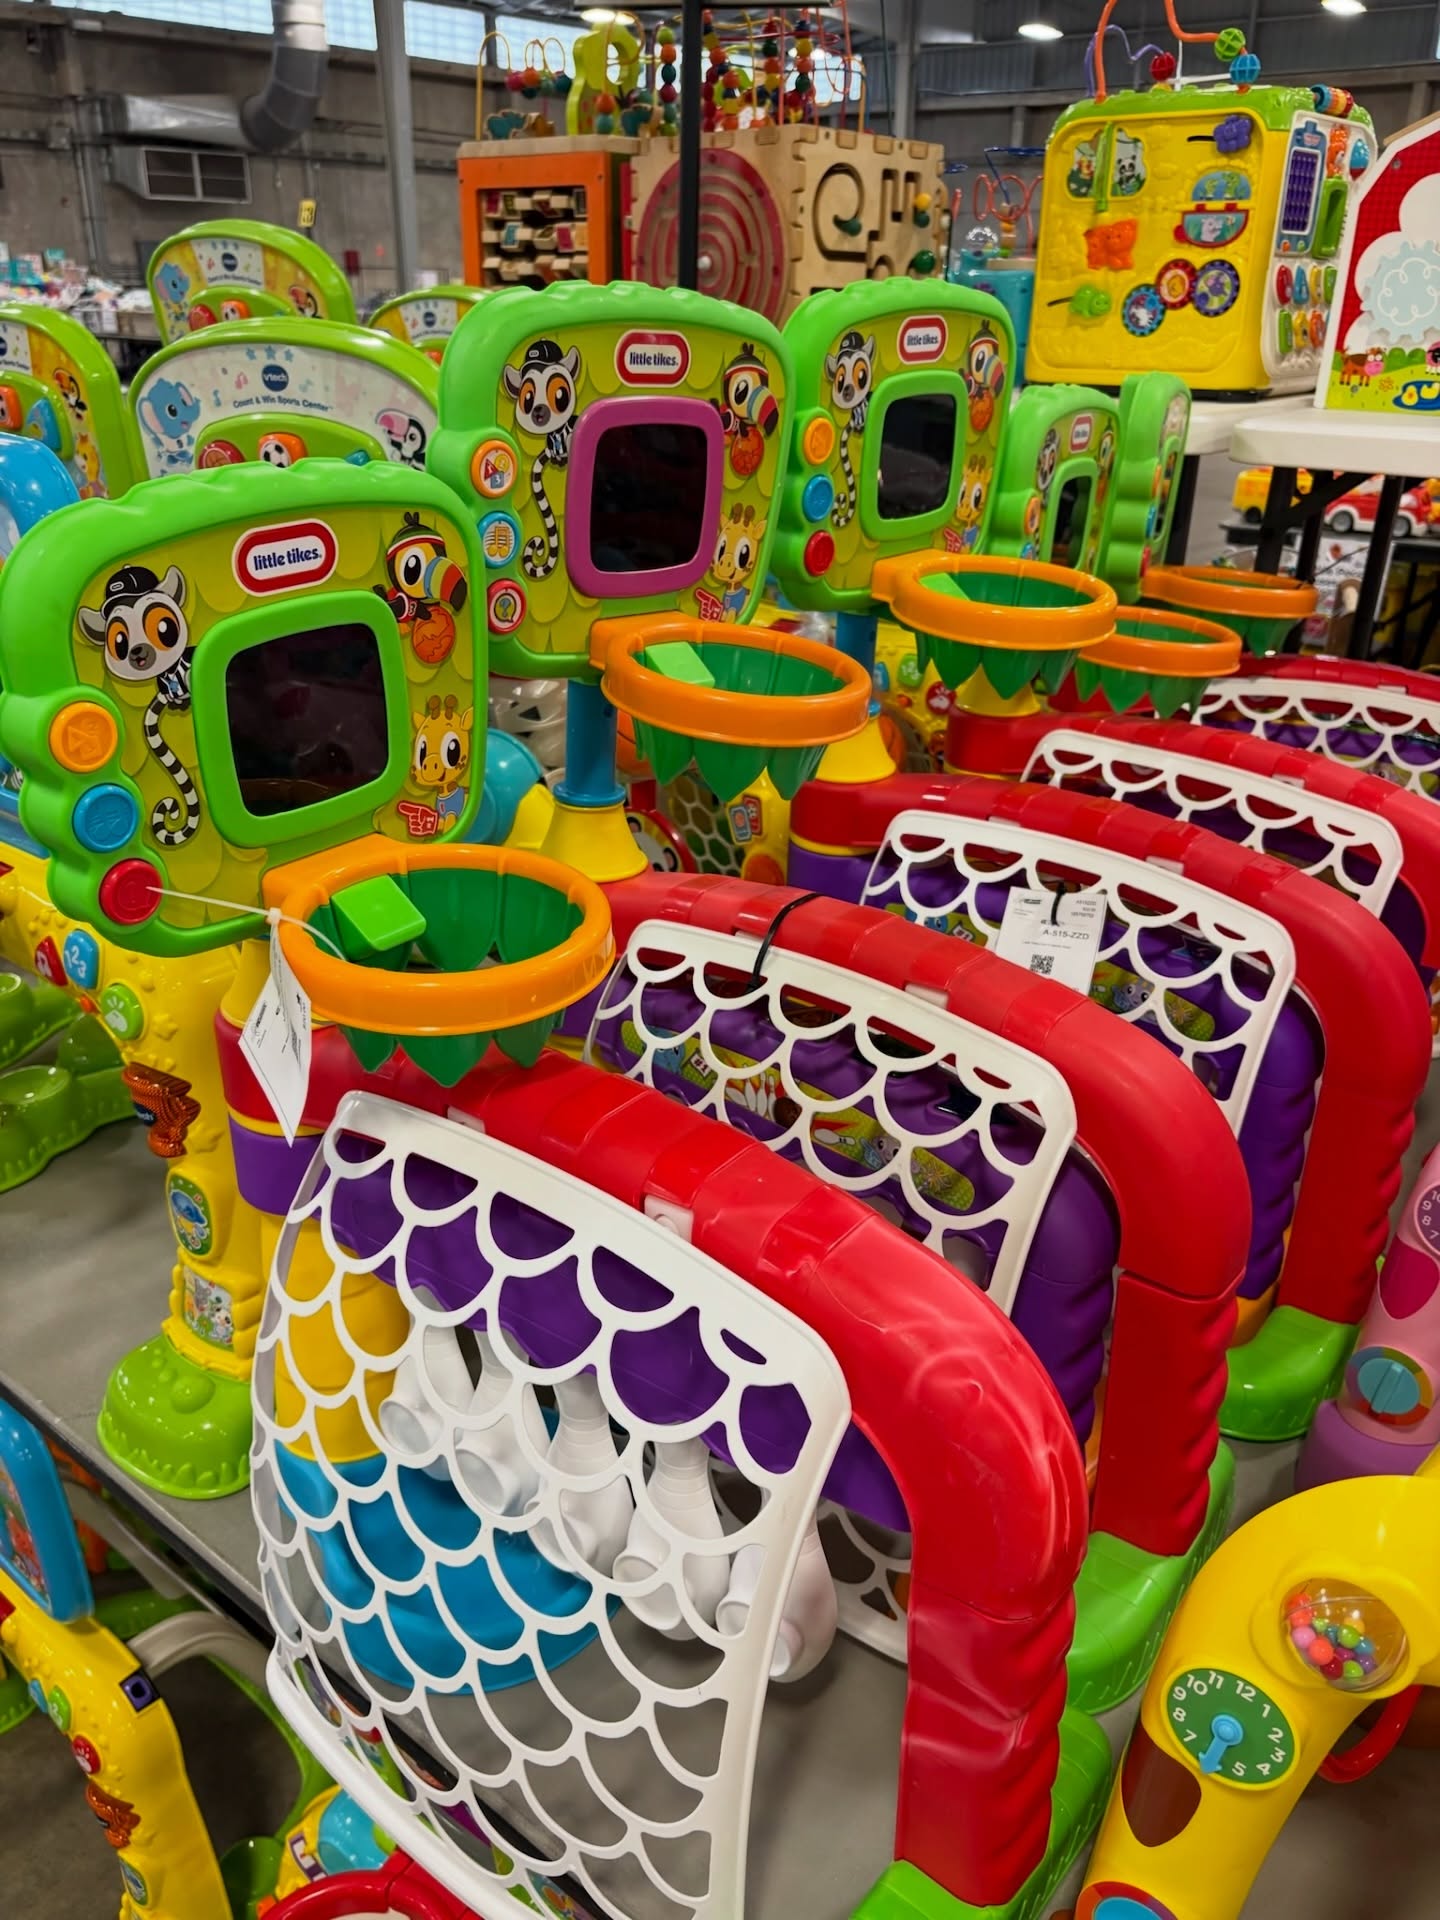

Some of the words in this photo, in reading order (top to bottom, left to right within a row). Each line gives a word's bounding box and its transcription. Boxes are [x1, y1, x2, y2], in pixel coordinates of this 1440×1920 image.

[629, 351, 652, 366] little
[233, 397, 254, 409] Count
[262, 395, 276, 404] Win
[278, 395, 300, 406] Sports
[253, 552, 285, 571] little
[1422, 1200, 1432, 1211] 9
[1421, 1215, 1432, 1226] 8
[1429, 1230, 1439, 1240] 7
[1186, 1674, 1208, 1696] 10
[1208, 1670, 1224, 1690] 11
[1173, 1686, 1187, 1701] 9
[1235, 1680, 1257, 1703] 12
[1172, 1707, 1187, 1722] 8
[1262, 1703, 1271, 1718] 1
[1183, 1729, 1197, 1743] 7
[1268, 1727, 1284, 1744] 2
[1270, 1747, 1287, 1763] 3
[1232, 1761, 1247, 1777] 5
[1256, 1762, 1272, 1776] 4
